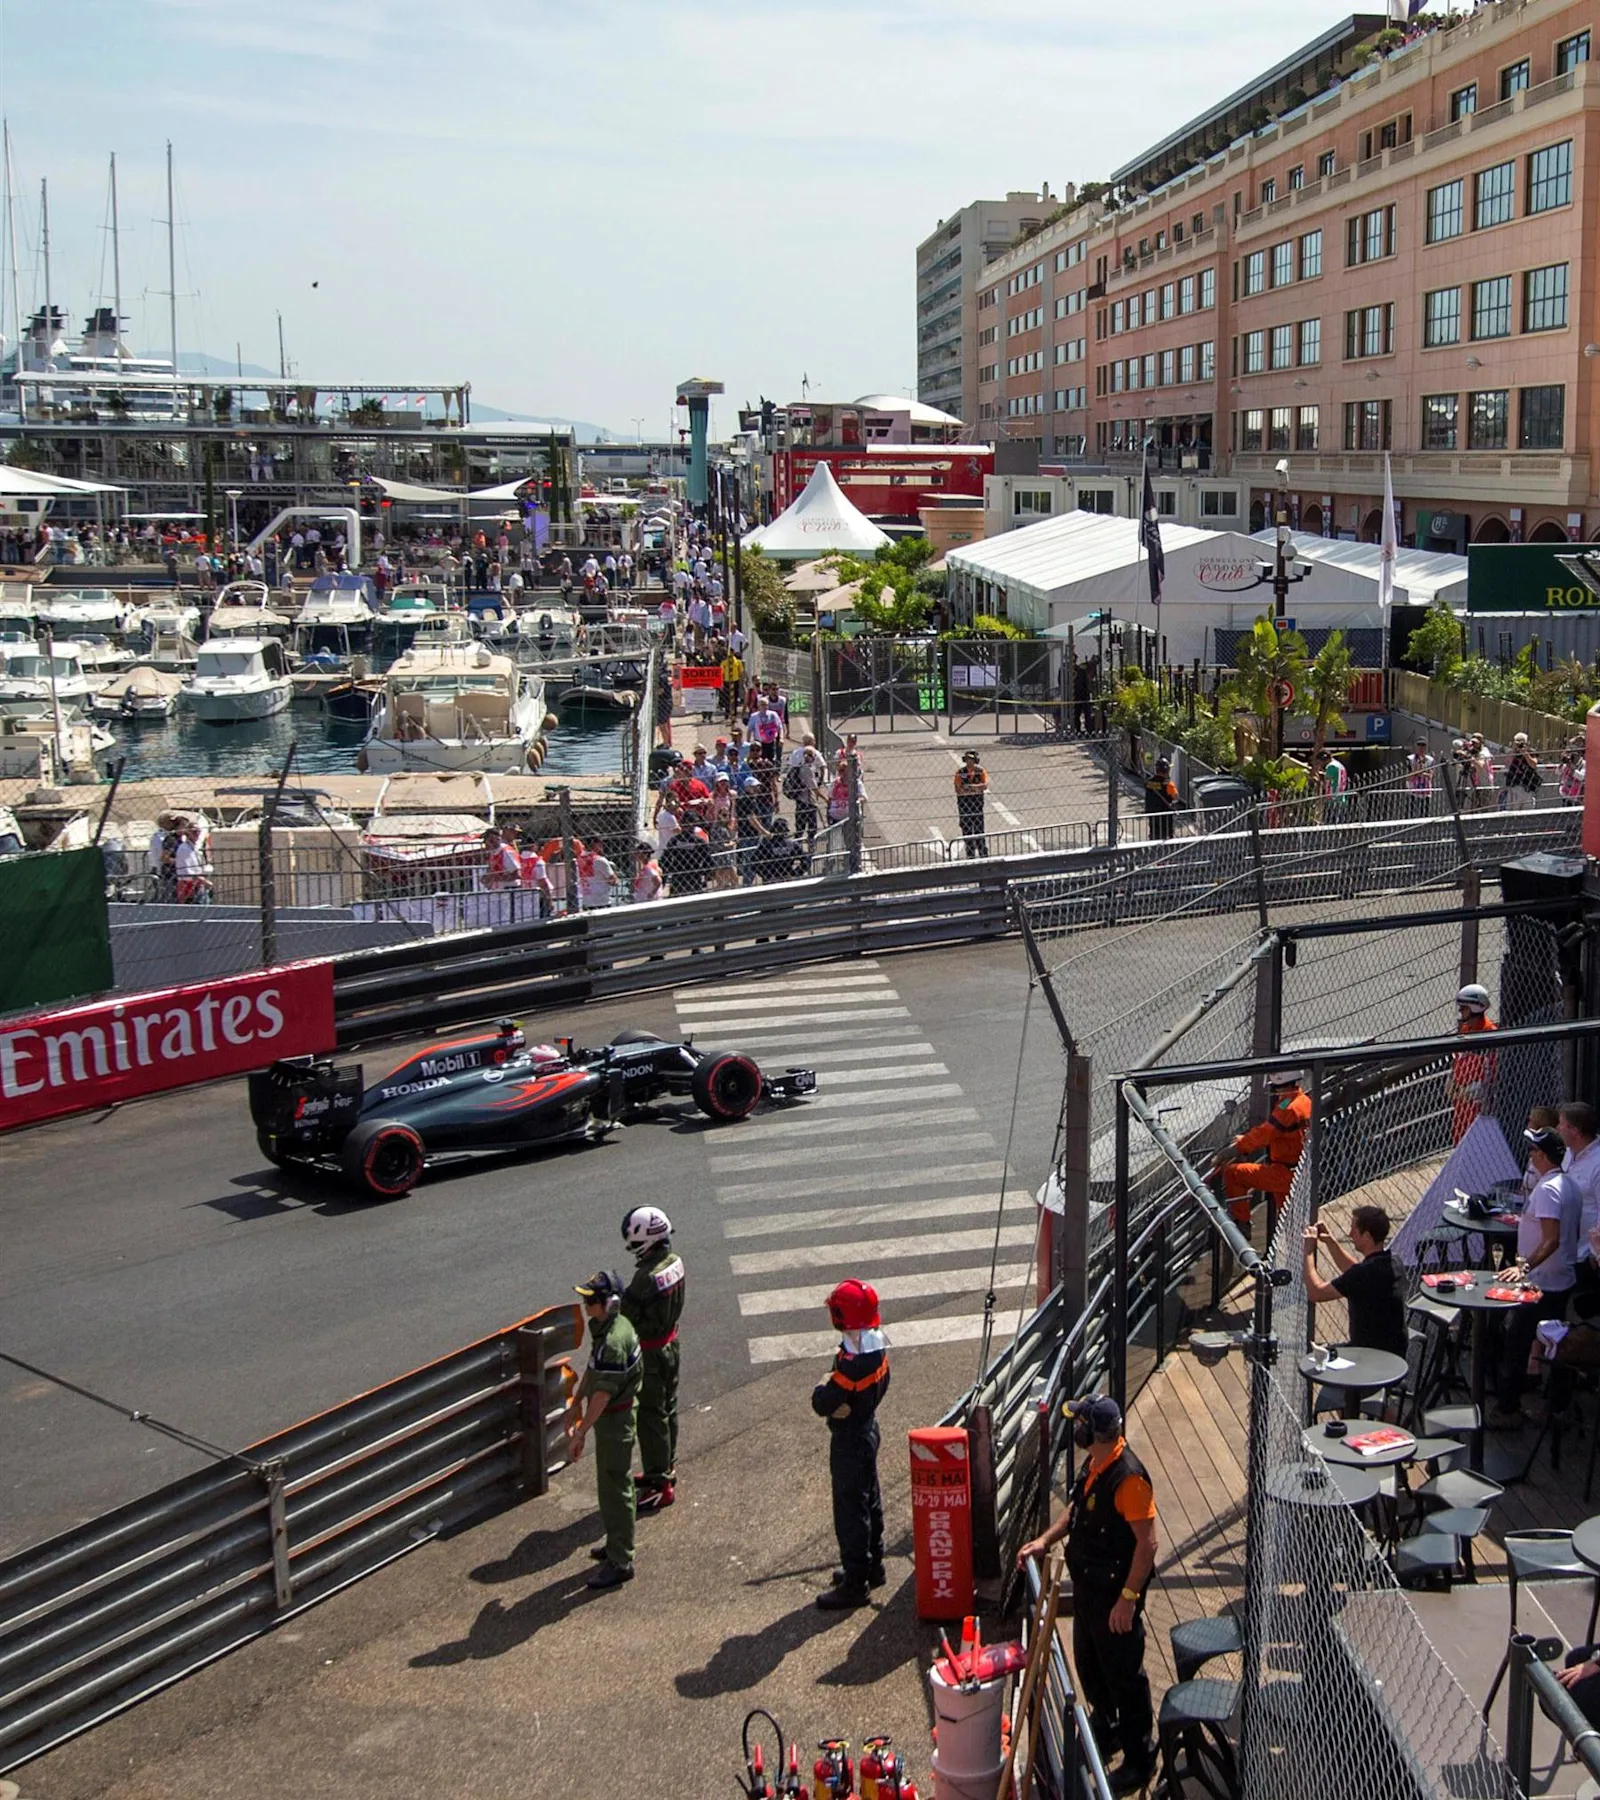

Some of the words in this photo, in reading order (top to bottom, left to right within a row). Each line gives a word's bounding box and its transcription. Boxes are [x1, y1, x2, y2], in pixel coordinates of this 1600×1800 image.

[1199, 563, 1245, 584] Club
[683, 669, 720, 678] SORTIE
[1374, 717, 1385, 732] P
[0, 989, 284, 1099] Emirates
[420, 1055, 466, 1077] Mobil
[381, 1077, 453, 1099] HONDA
[795, 1073, 814, 1087] CNN
[941, 1470, 966, 1486] MAI
[913, 1493, 940, 1508] 26-29
[943, 1492, 967, 1508] MAI
[929, 1511, 952, 1557] GRAND
[931, 1561, 955, 1598] PRIX
